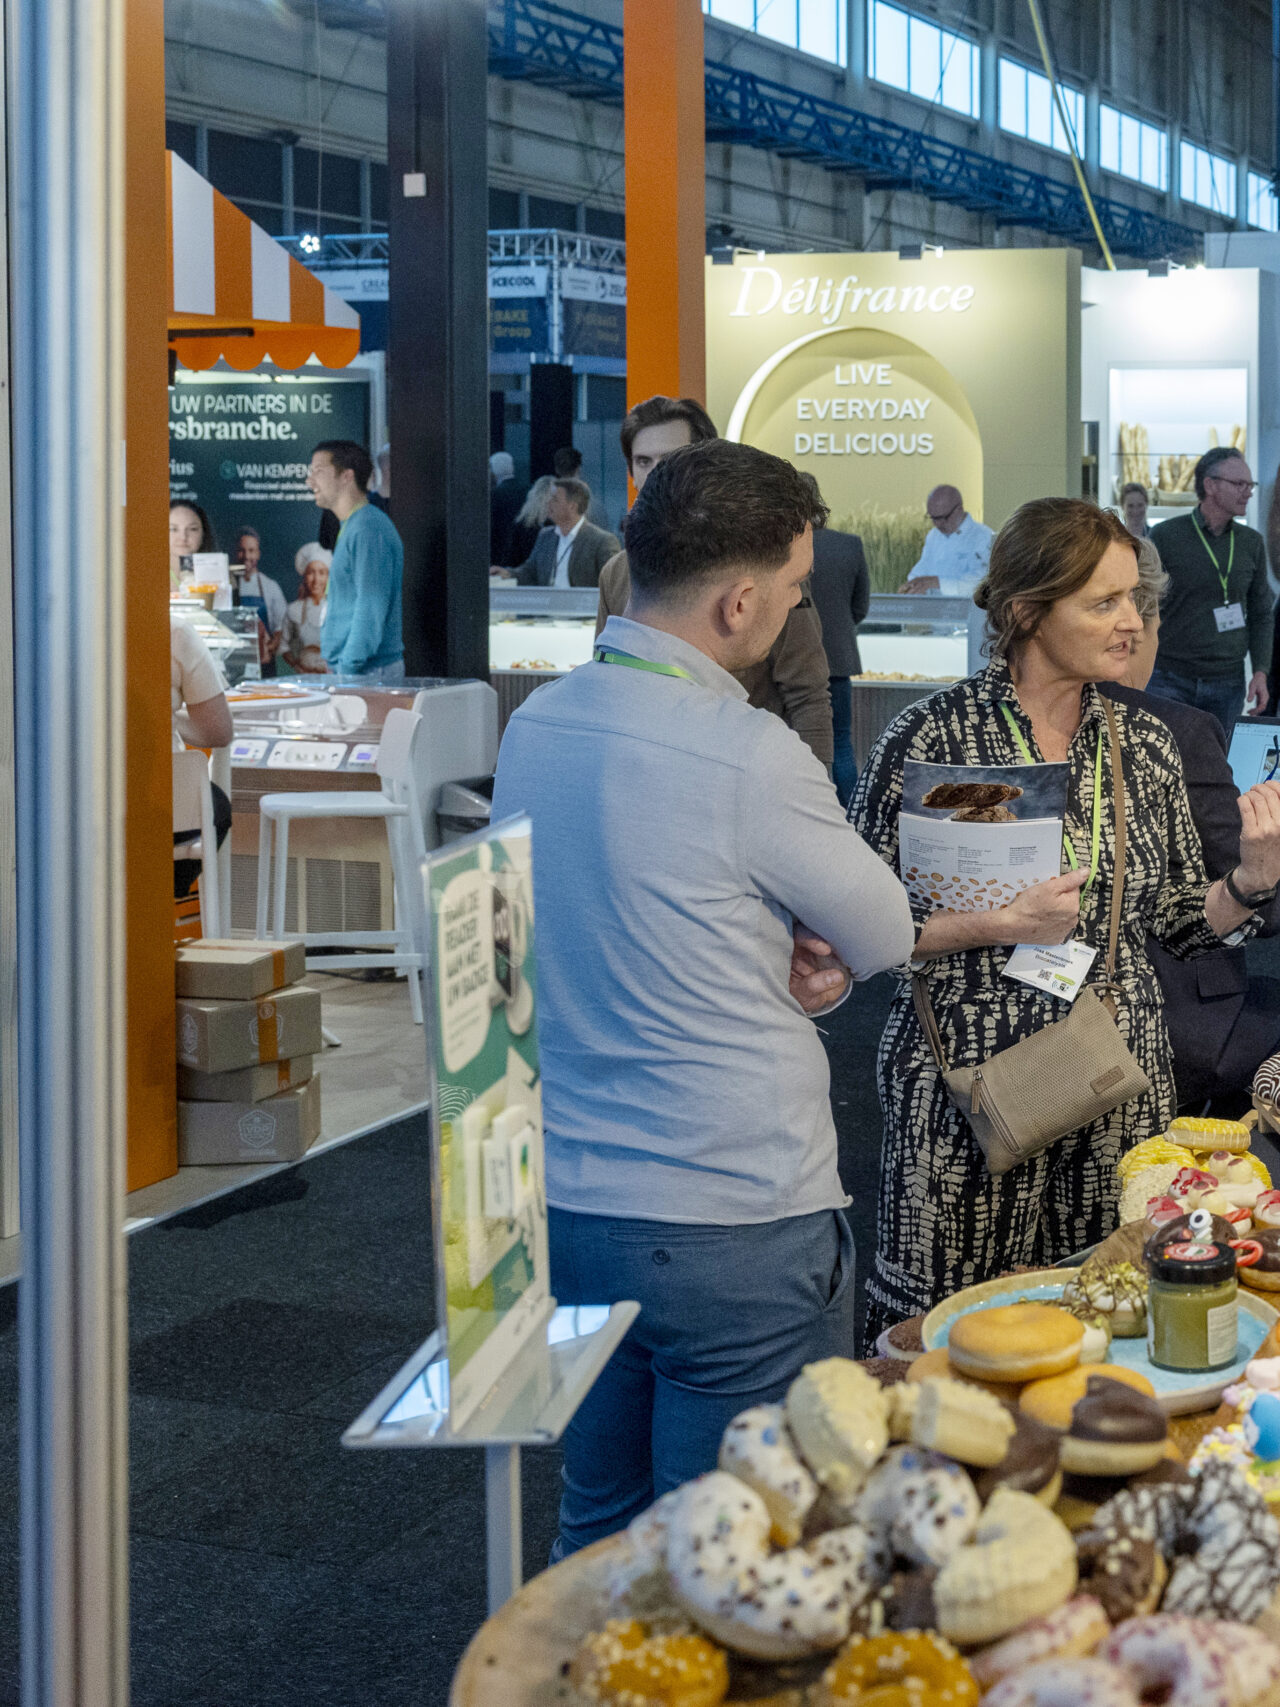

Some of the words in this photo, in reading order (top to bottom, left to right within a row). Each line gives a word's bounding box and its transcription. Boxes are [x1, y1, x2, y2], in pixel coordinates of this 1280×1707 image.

[492, 276, 535, 288] ICECOOL
[729, 267, 975, 325] Délifrance
[835, 364, 892, 385] LIVE
[172, 394, 200, 414] UW
[204, 394, 286, 414] PARTNERS
[290, 394, 307, 414] IN
[311, 394, 333, 414] DE
[797, 398, 931, 420] EVERYDAY
[795, 433, 934, 455] DELICIOUS
